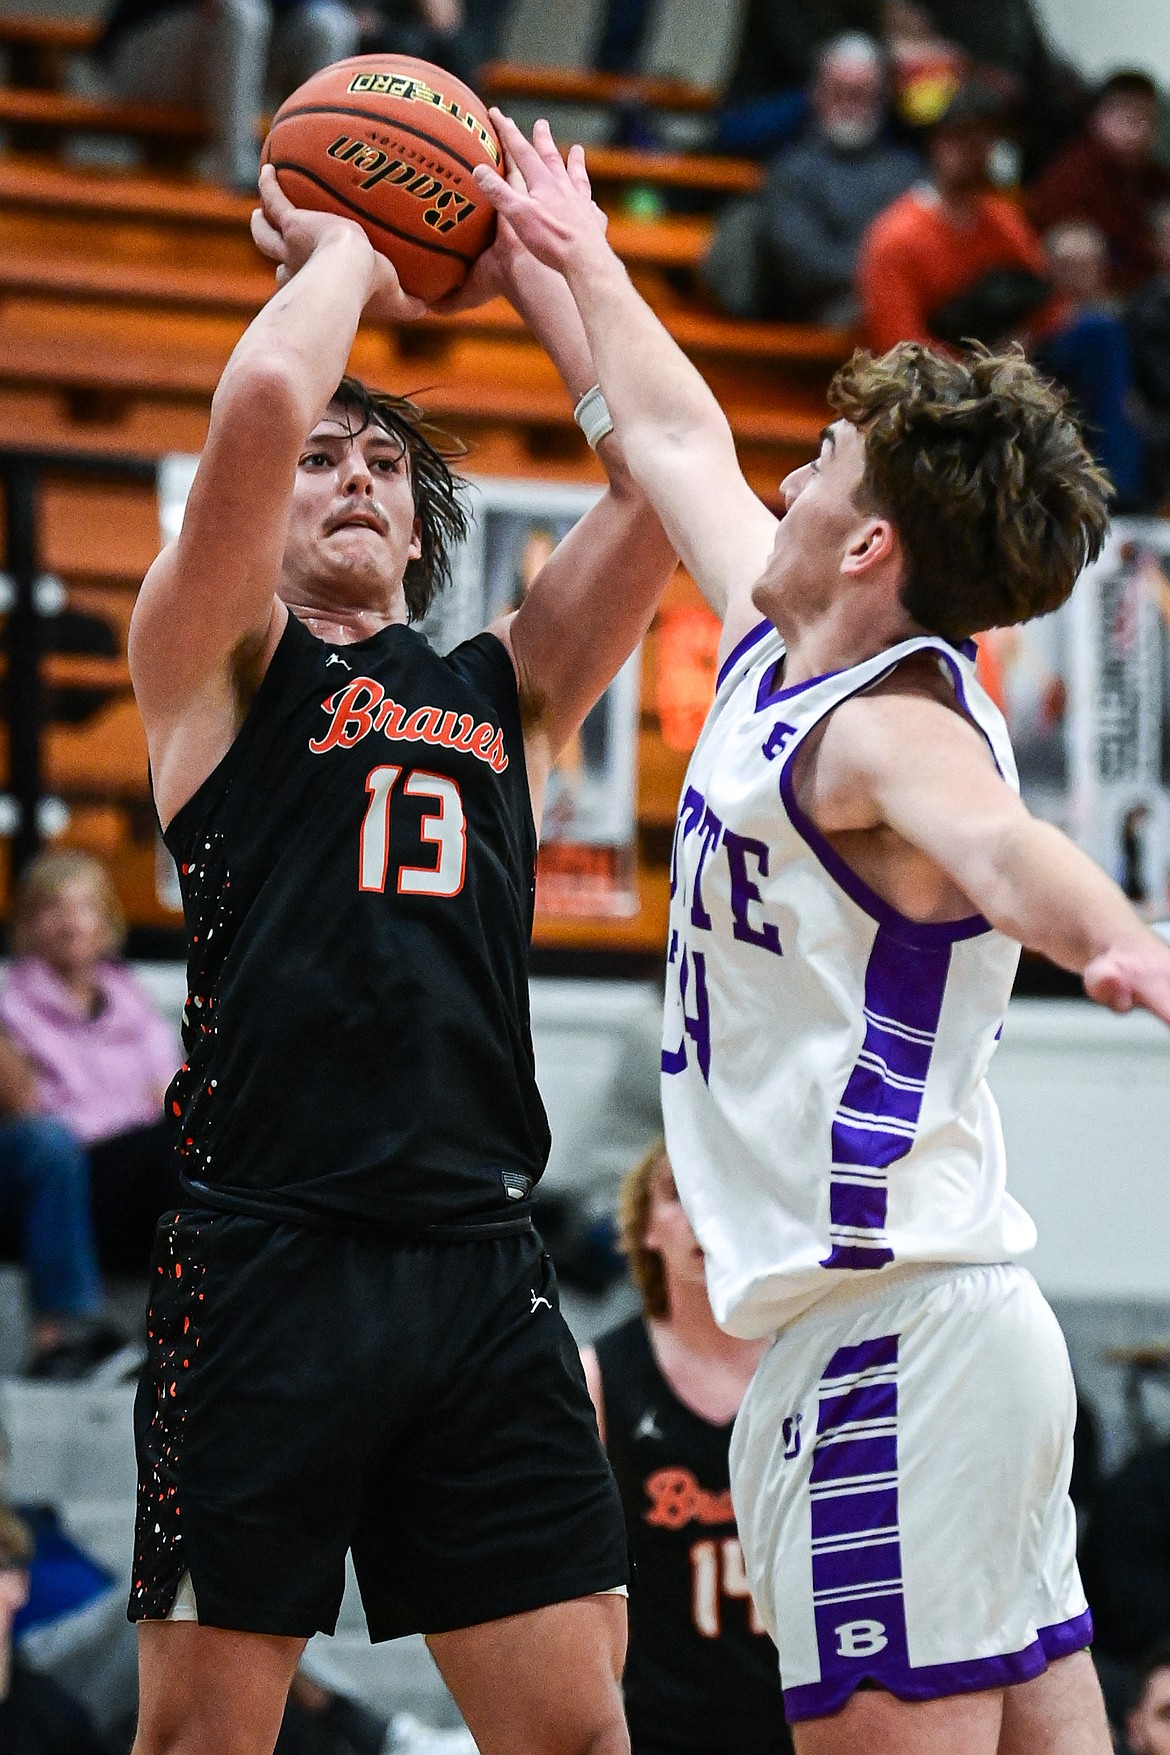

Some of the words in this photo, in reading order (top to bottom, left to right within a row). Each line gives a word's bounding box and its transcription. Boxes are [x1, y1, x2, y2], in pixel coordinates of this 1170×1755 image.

[327, 134, 477, 235] Baden
[309, 676, 509, 774] Braves
[358, 763, 468, 898] 13
[669, 784, 784, 957] TTE
[834, 1619, 889, 1658] B
